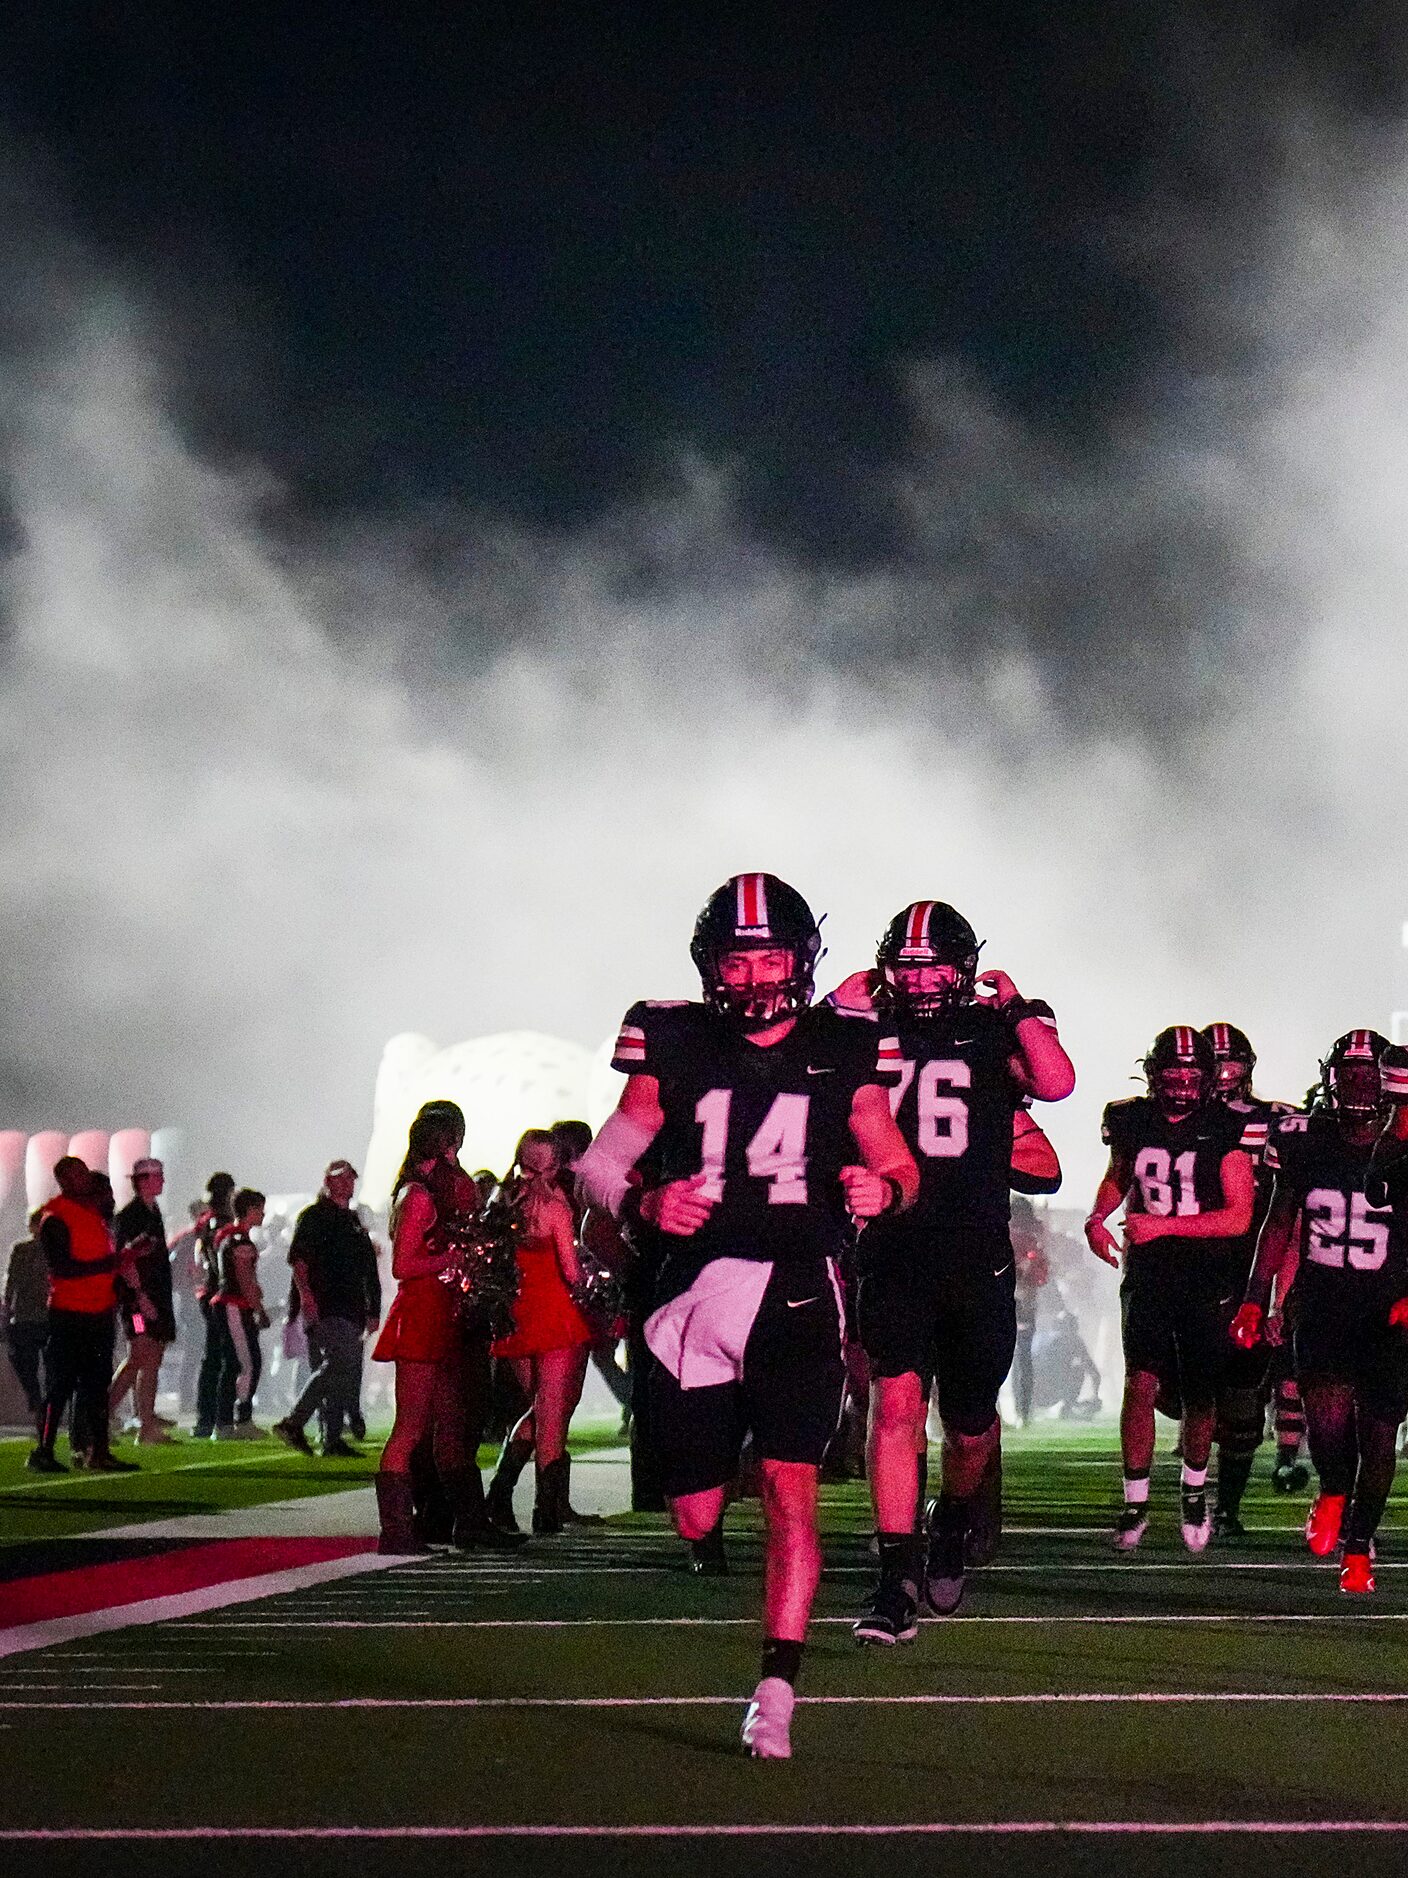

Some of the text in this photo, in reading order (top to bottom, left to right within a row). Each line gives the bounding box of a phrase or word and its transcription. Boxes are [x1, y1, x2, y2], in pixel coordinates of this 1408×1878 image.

[694, 1087, 812, 1204] 14
[888, 1059, 972, 1156] 76
[1134, 1146, 1201, 1217] 81
[1304, 1188, 1394, 1271] 25
